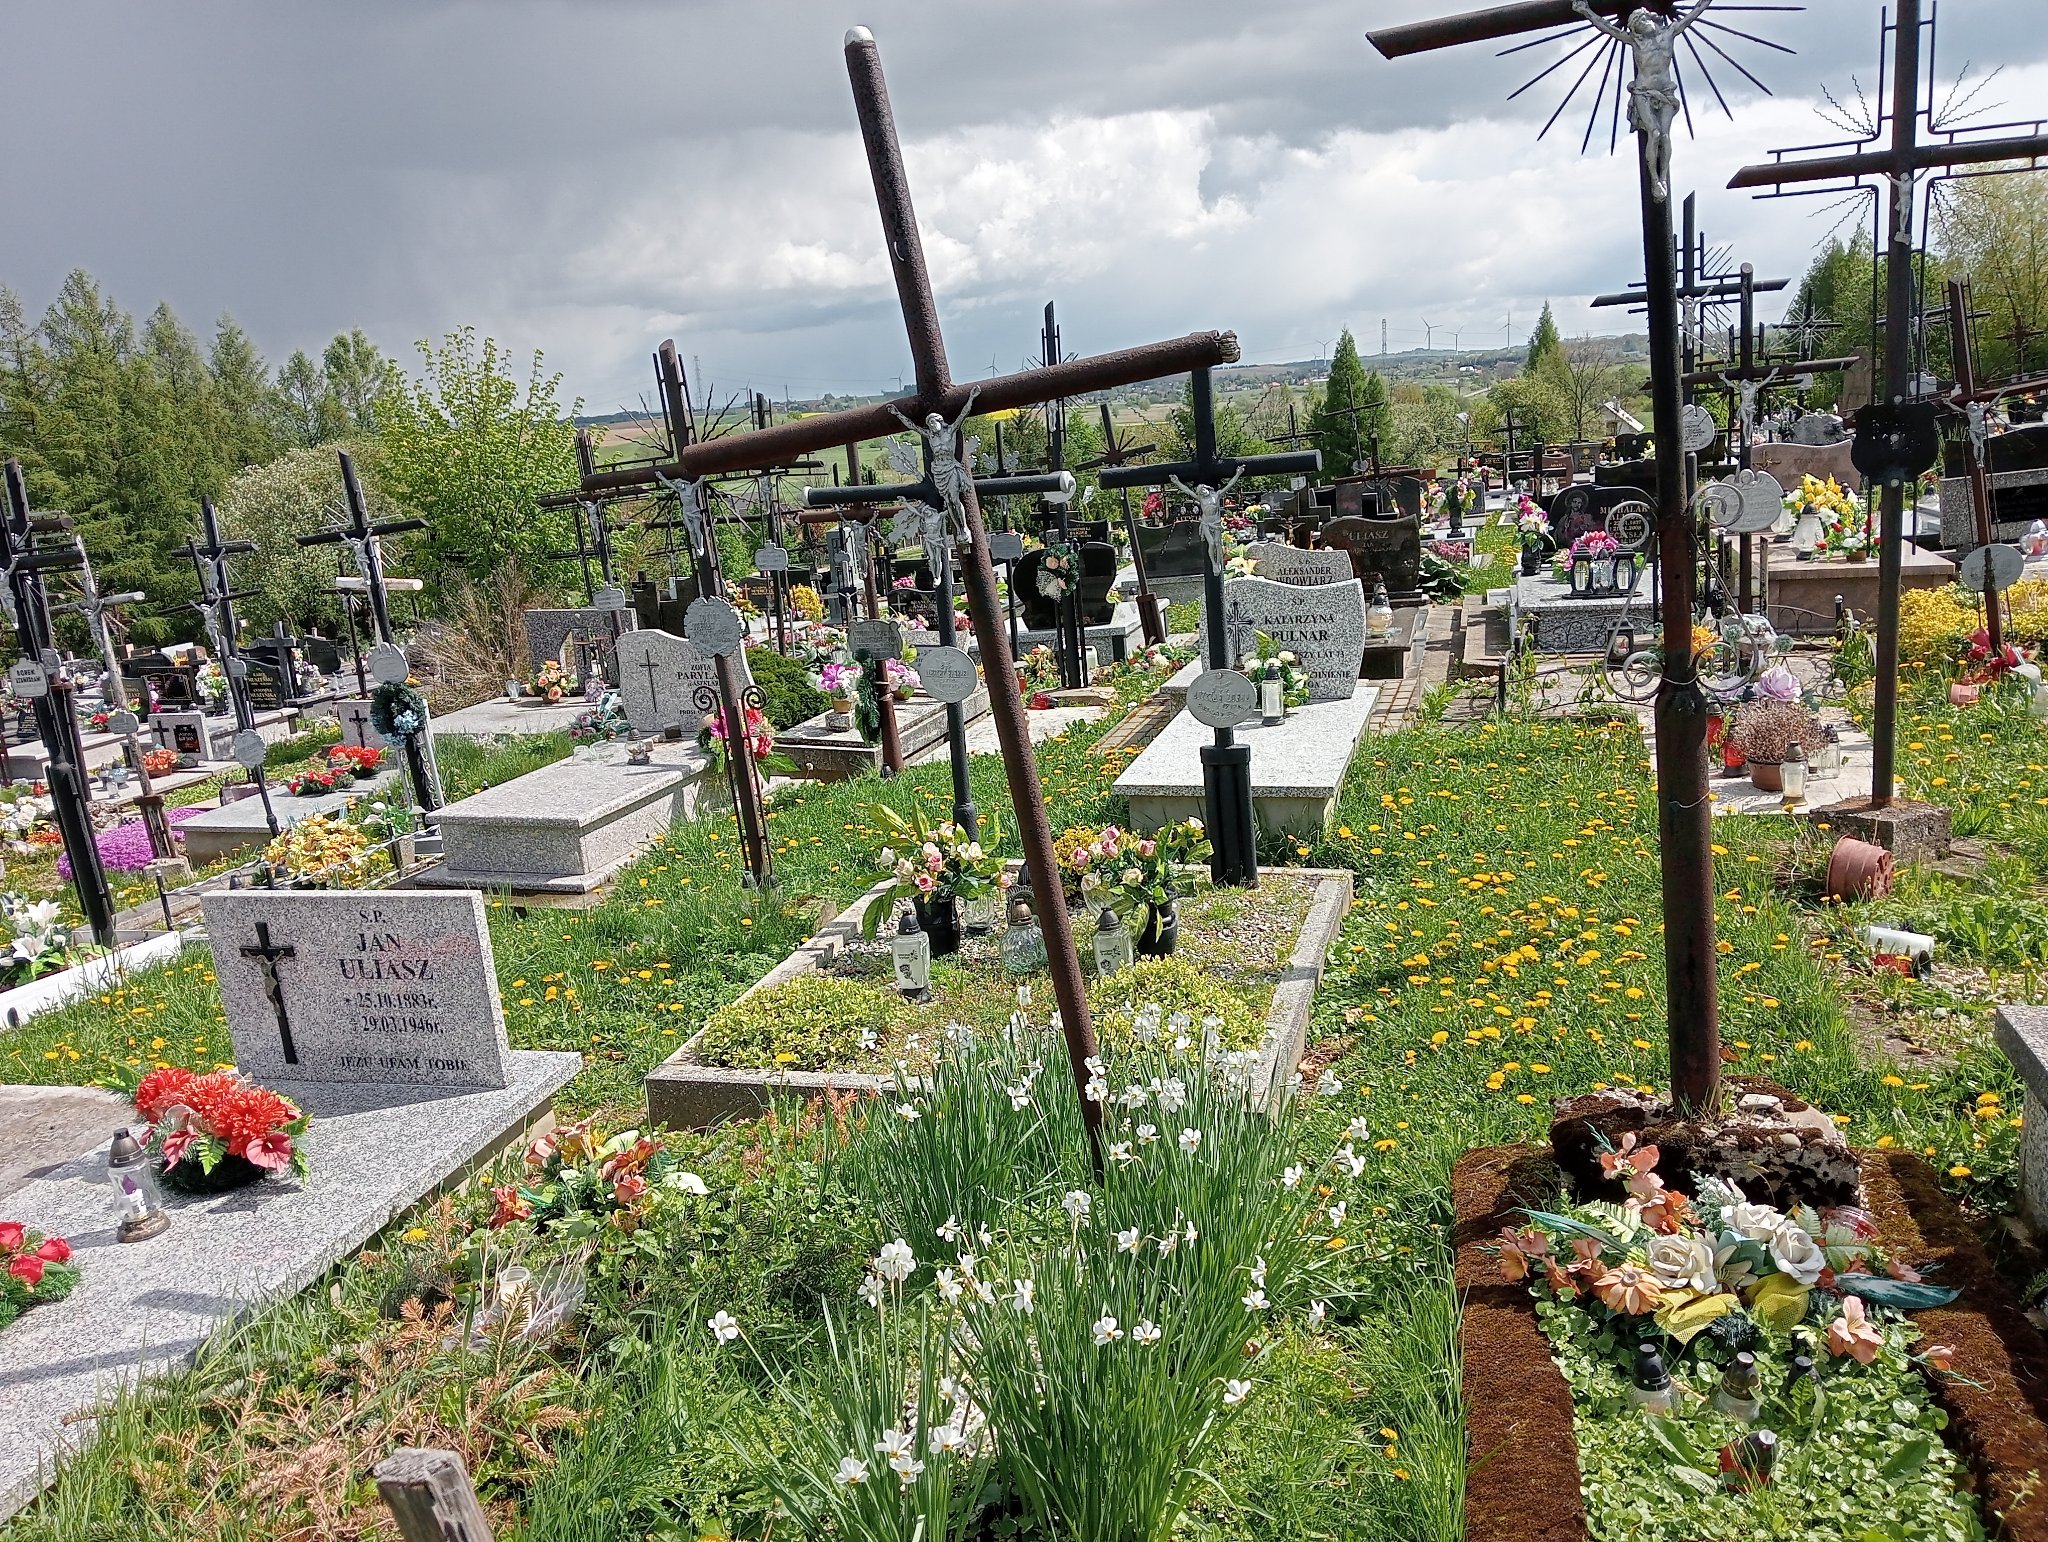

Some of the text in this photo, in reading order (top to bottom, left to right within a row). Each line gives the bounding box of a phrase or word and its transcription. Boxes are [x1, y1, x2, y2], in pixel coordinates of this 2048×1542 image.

[1600, 505, 1649, 514] MIHALAK
[1277, 566, 1332, 576] ALEKSANDER
[1275, 575, 1333, 587] WDOWIARZ
[1264, 613, 1335, 626] KATARZYNA
[1271, 629, 1329, 642] PULNAR
[690, 663, 712, 671] ZOFIA
[677, 671, 720, 680] PARYLA
[356, 932, 402, 952] JAN
[338, 957, 434, 981] ULIASZ
[340, 1056, 471, 1071] JEZU UFAM TOBIE
